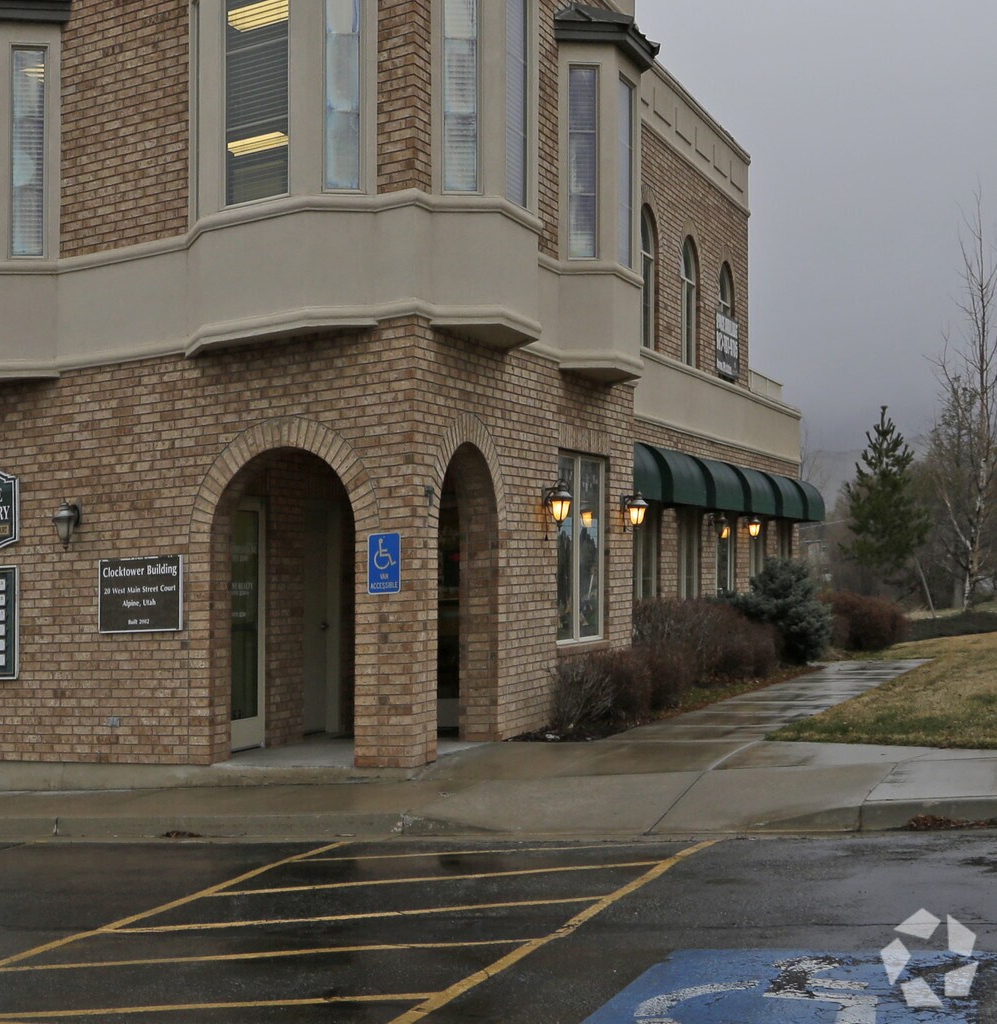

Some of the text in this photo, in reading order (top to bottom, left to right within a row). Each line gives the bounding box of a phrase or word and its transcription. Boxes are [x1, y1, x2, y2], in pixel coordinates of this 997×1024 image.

[102, 563, 178, 578] Clocktower Building
[103, 584, 176, 595] 20 West Main Street Court
[370, 581, 398, 590] ACCESSIBLE
[122, 598, 157, 608] Alpine, Utah
